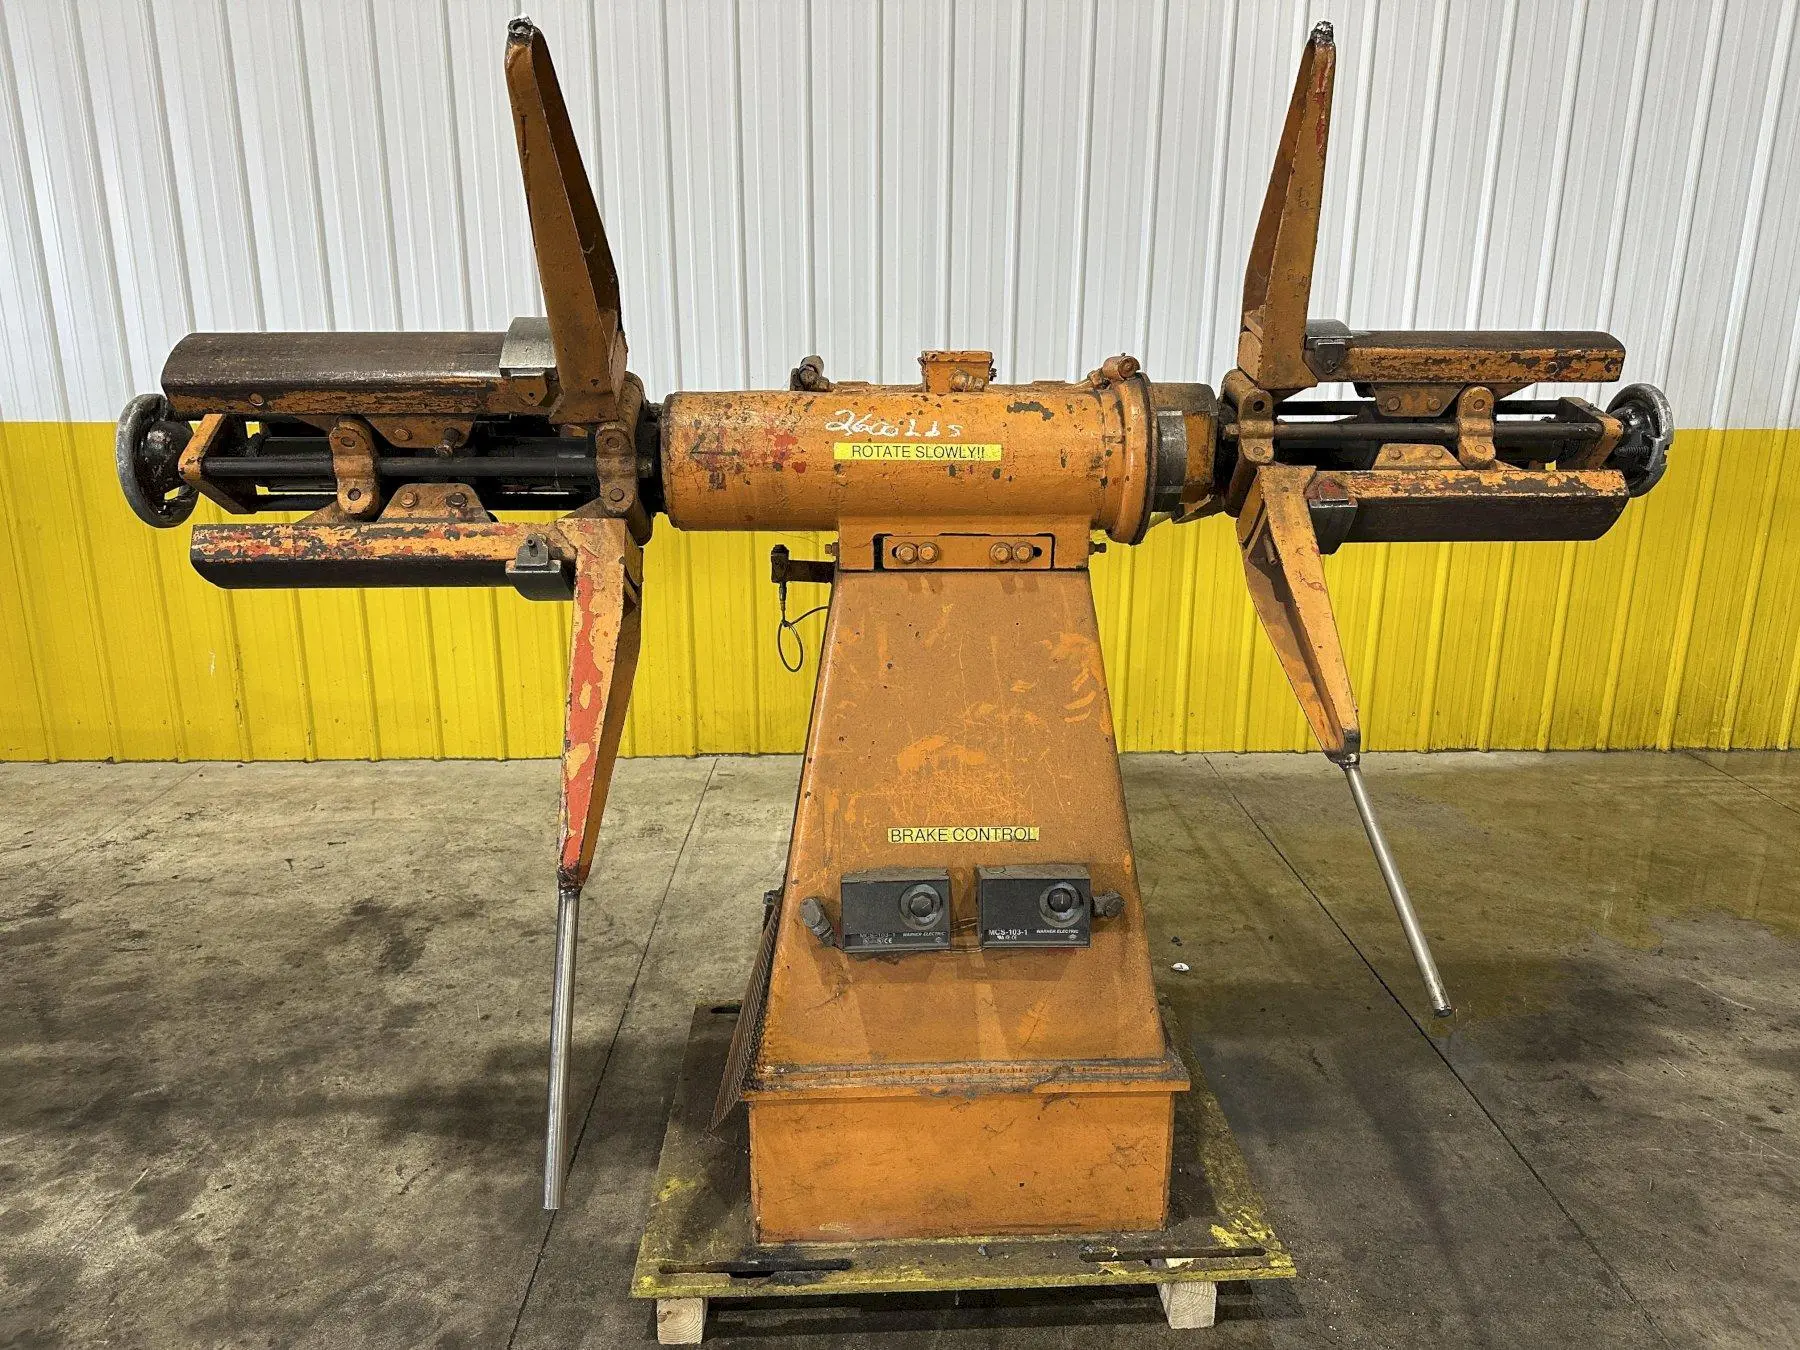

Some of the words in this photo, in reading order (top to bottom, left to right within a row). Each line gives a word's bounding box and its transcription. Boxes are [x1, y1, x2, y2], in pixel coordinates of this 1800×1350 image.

[852, 445, 910, 458] ROTATE
[915, 445, 985, 459] SLOWLY!!
[891, 828, 948, 842] BRAKE
[953, 827, 1037, 841] CONTROL
